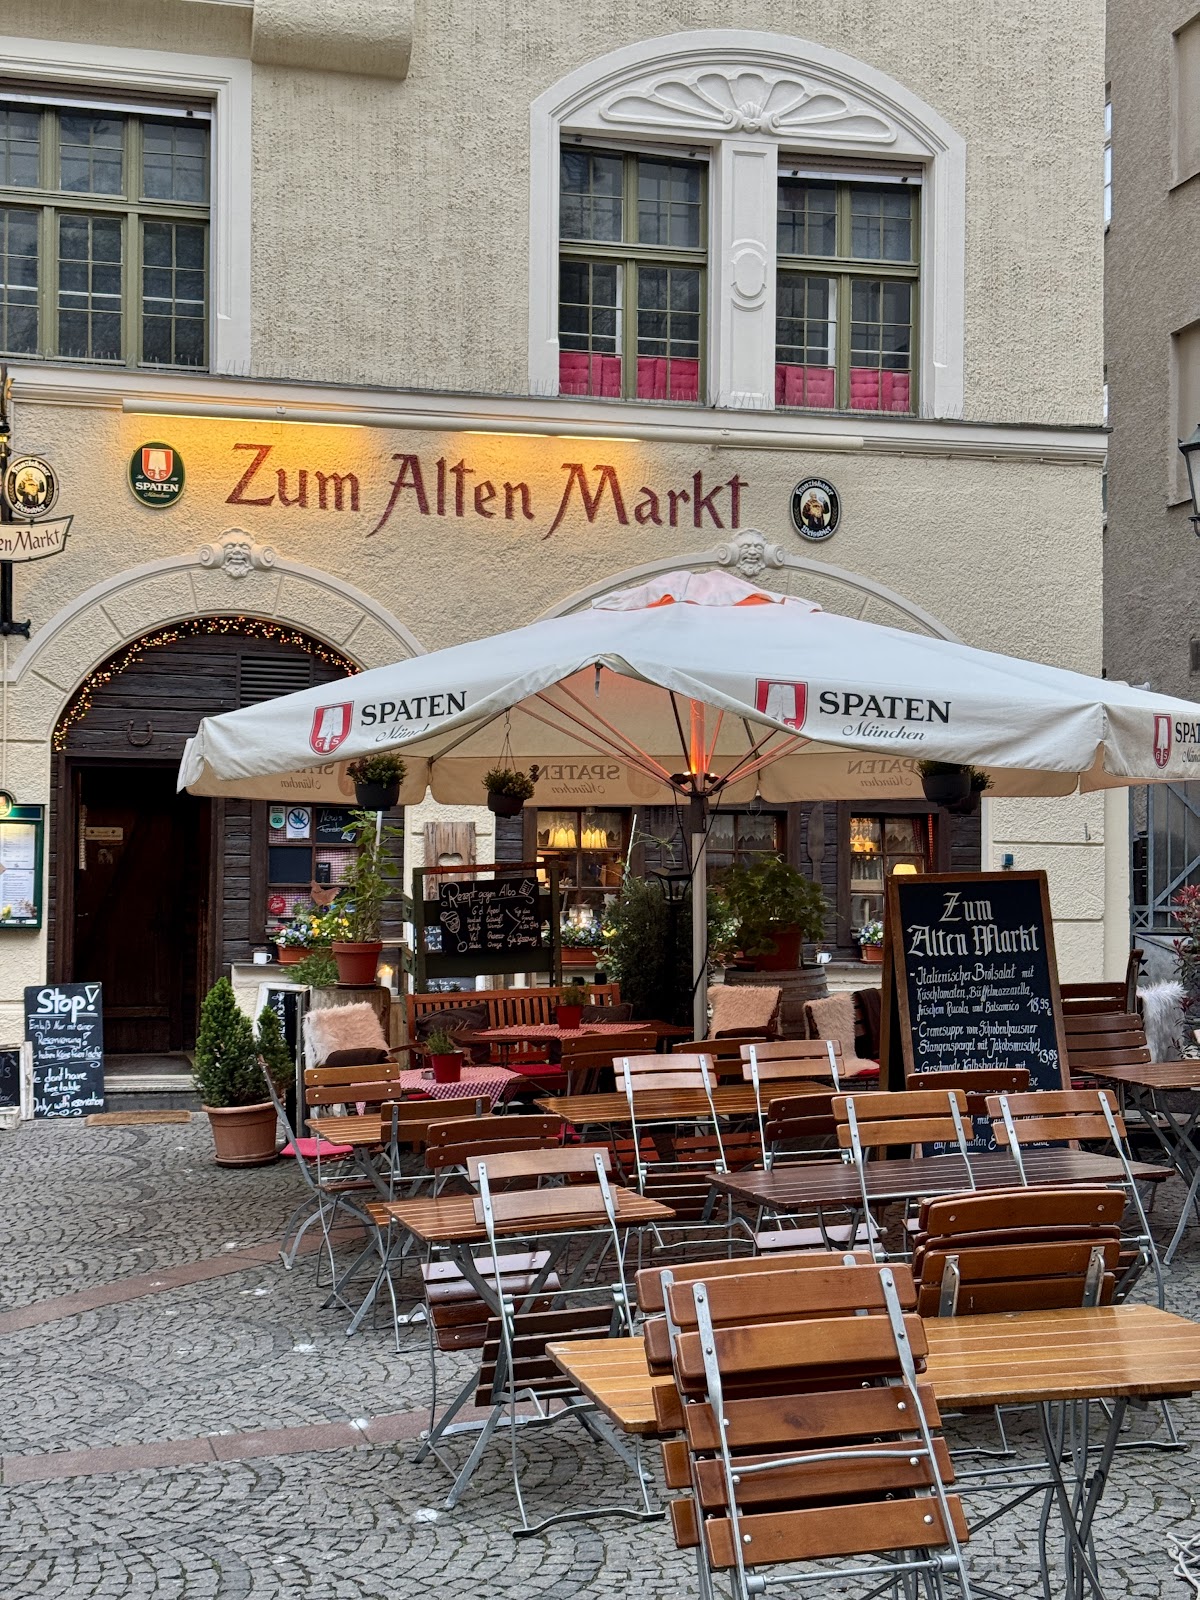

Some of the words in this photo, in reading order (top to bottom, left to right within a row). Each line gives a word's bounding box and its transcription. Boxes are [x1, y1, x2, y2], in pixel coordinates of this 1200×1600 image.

[135, 481, 179, 493] SPATEN
[224, 443, 360, 511] Zum
[365, 453, 536, 538] Alten
[541, 463, 750, 541] Markt
[795, 480, 835, 496] Franziskaner
[10, 528, 60, 556] Markt
[361, 690, 468, 727] SPATEN
[819, 690, 952, 724] SPATEN
[331, 736, 340, 746] S
[842, 720, 927, 741] München
[939, 892, 995, 922] Zum
[907, 924, 969, 957] Alten
[971, 923, 1040, 957] Markt
[916, 966, 972, 986] Italienischer
[971, 963, 1018, 982] Brotsalat
[1021, 965, 1035, 978] mit
[37, 985, 100, 1023] Stop!
[946, 1000, 970, 1017] Rucola
[985, 1001, 1020, 1014] Balsamico
[918, 1021, 965, 1040] Cremesuppe
[977, 1038, 988, 1051] mit
[65, 1068, 88, 1081] have
[60, 1080, 81, 1092] table
